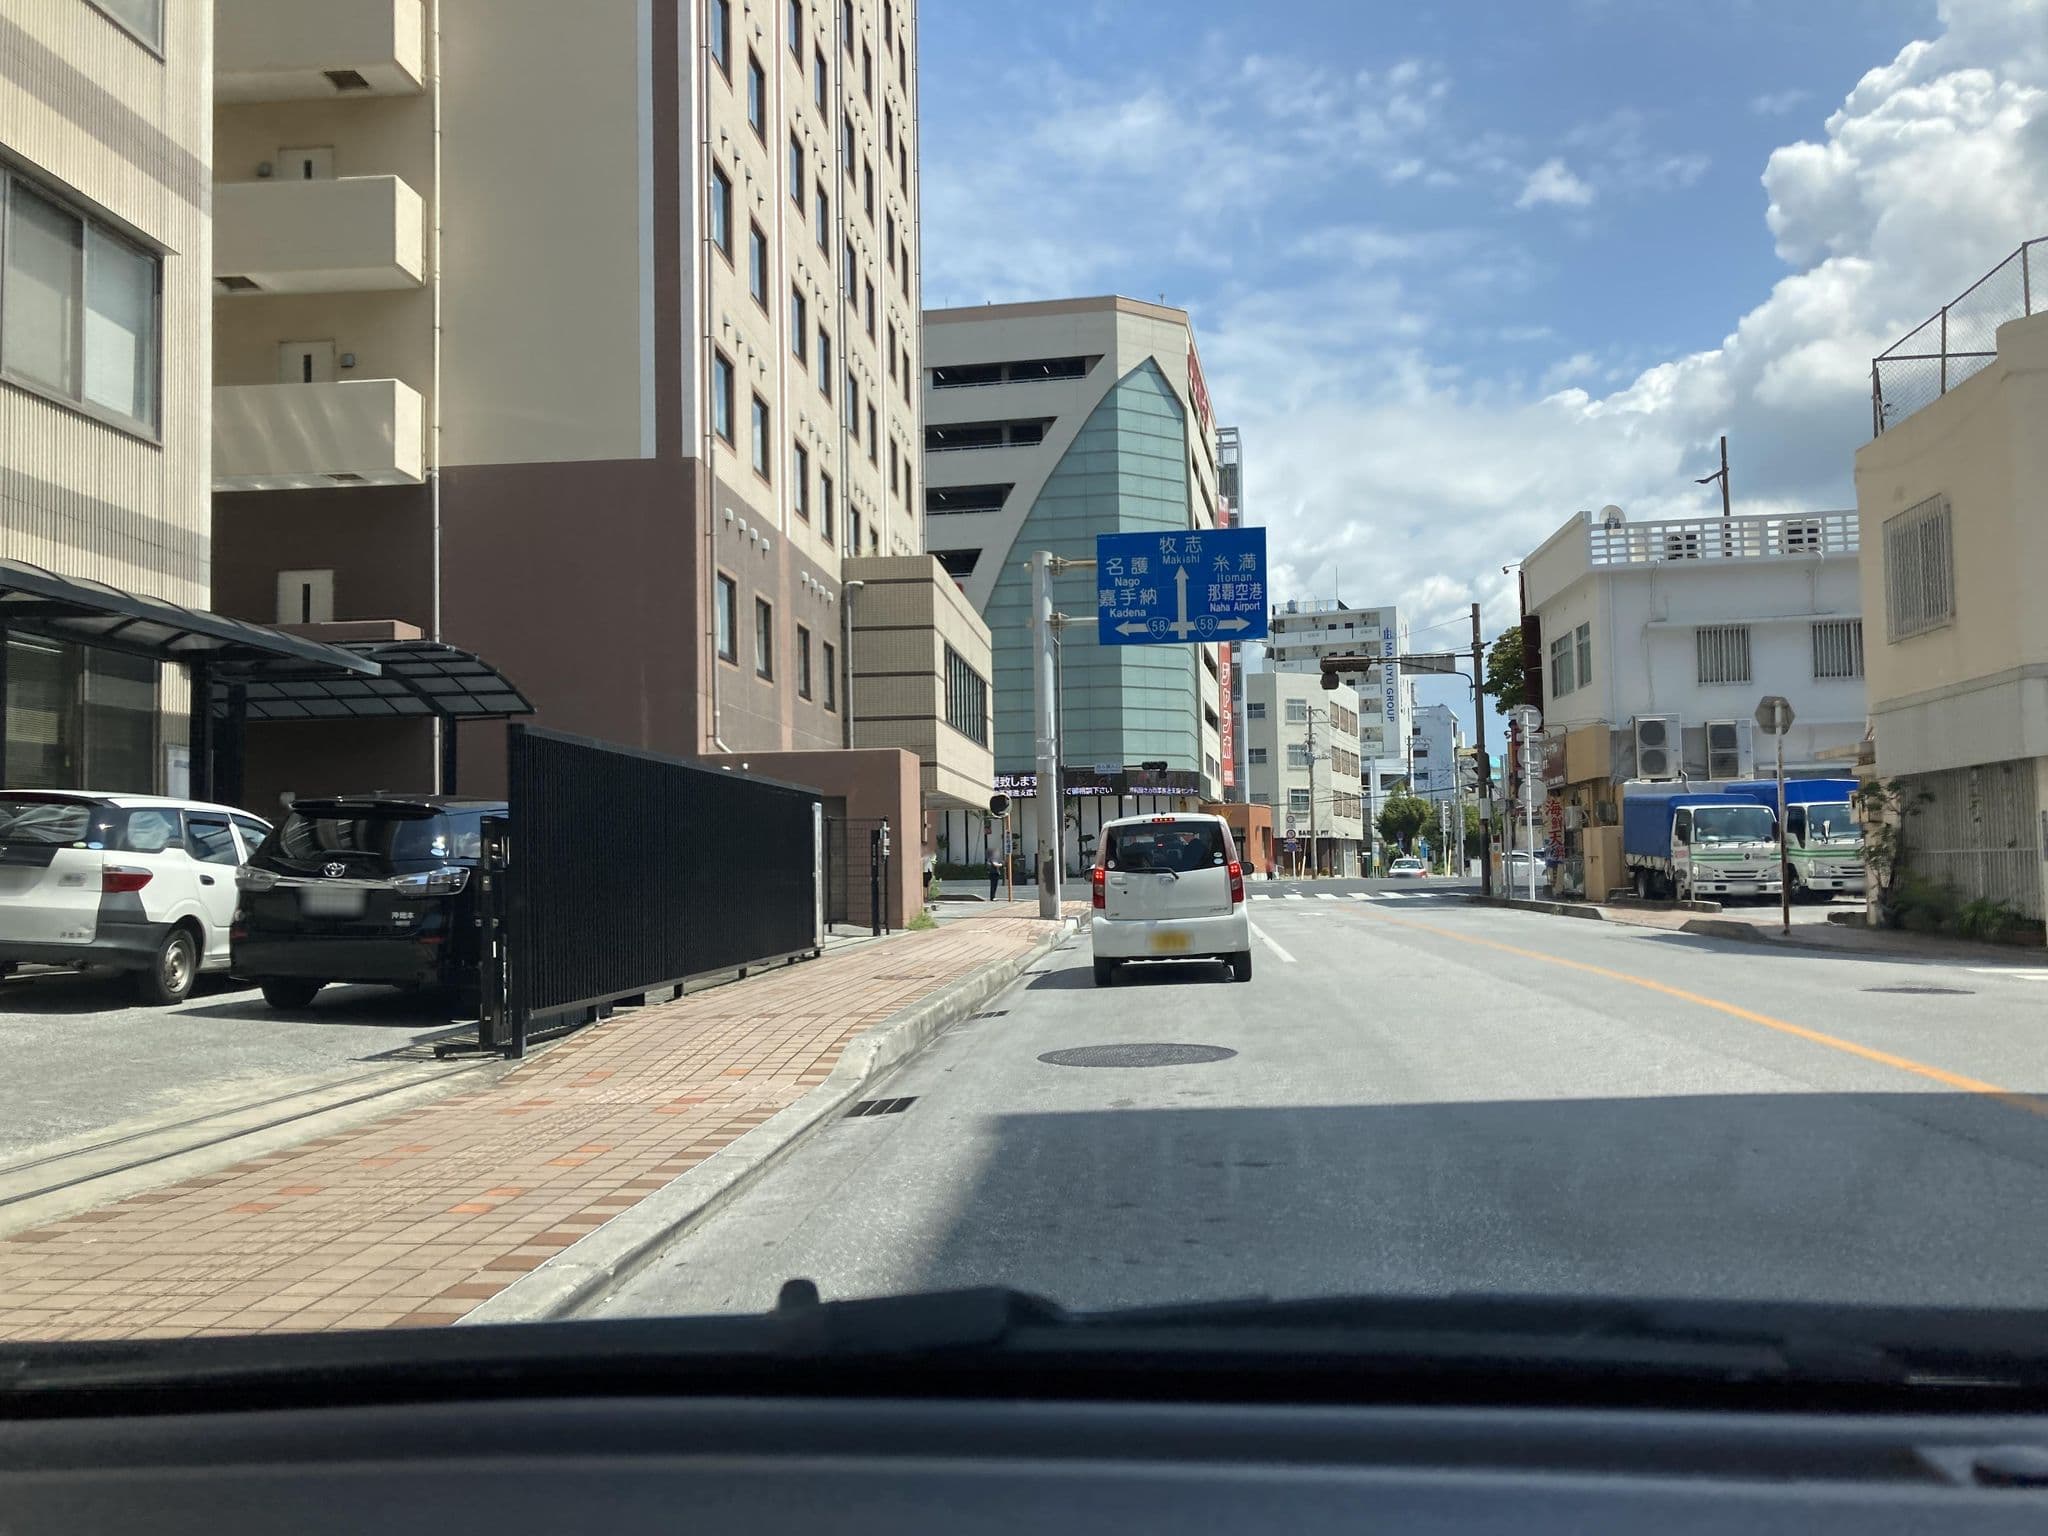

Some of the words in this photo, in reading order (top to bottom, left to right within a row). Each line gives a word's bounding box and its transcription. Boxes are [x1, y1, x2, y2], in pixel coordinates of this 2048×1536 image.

[1159, 536, 1203, 554] 牧志
[1106, 557, 1149, 575] 名護
[1162, 555, 1200, 565] Makishi
[1213, 553, 1256, 572] 糸満
[1115, 577, 1140, 587] Nago
[1217, 573, 1252, 582] Itoman
[1099, 587, 1157, 607] 嘉手納
[1208, 583, 1263, 601] 那覇空港
[1109, 608, 1146, 618] Kadena
[1210, 603, 1230, 612] Naha
[1233, 601, 1261, 612] Airport
[1151, 620, 1166, 632] 58
[1200, 618, 1214, 630] 58
[1385, 642, 1393, 685] MAUYU
[1386, 688, 1395, 722] GROUP
